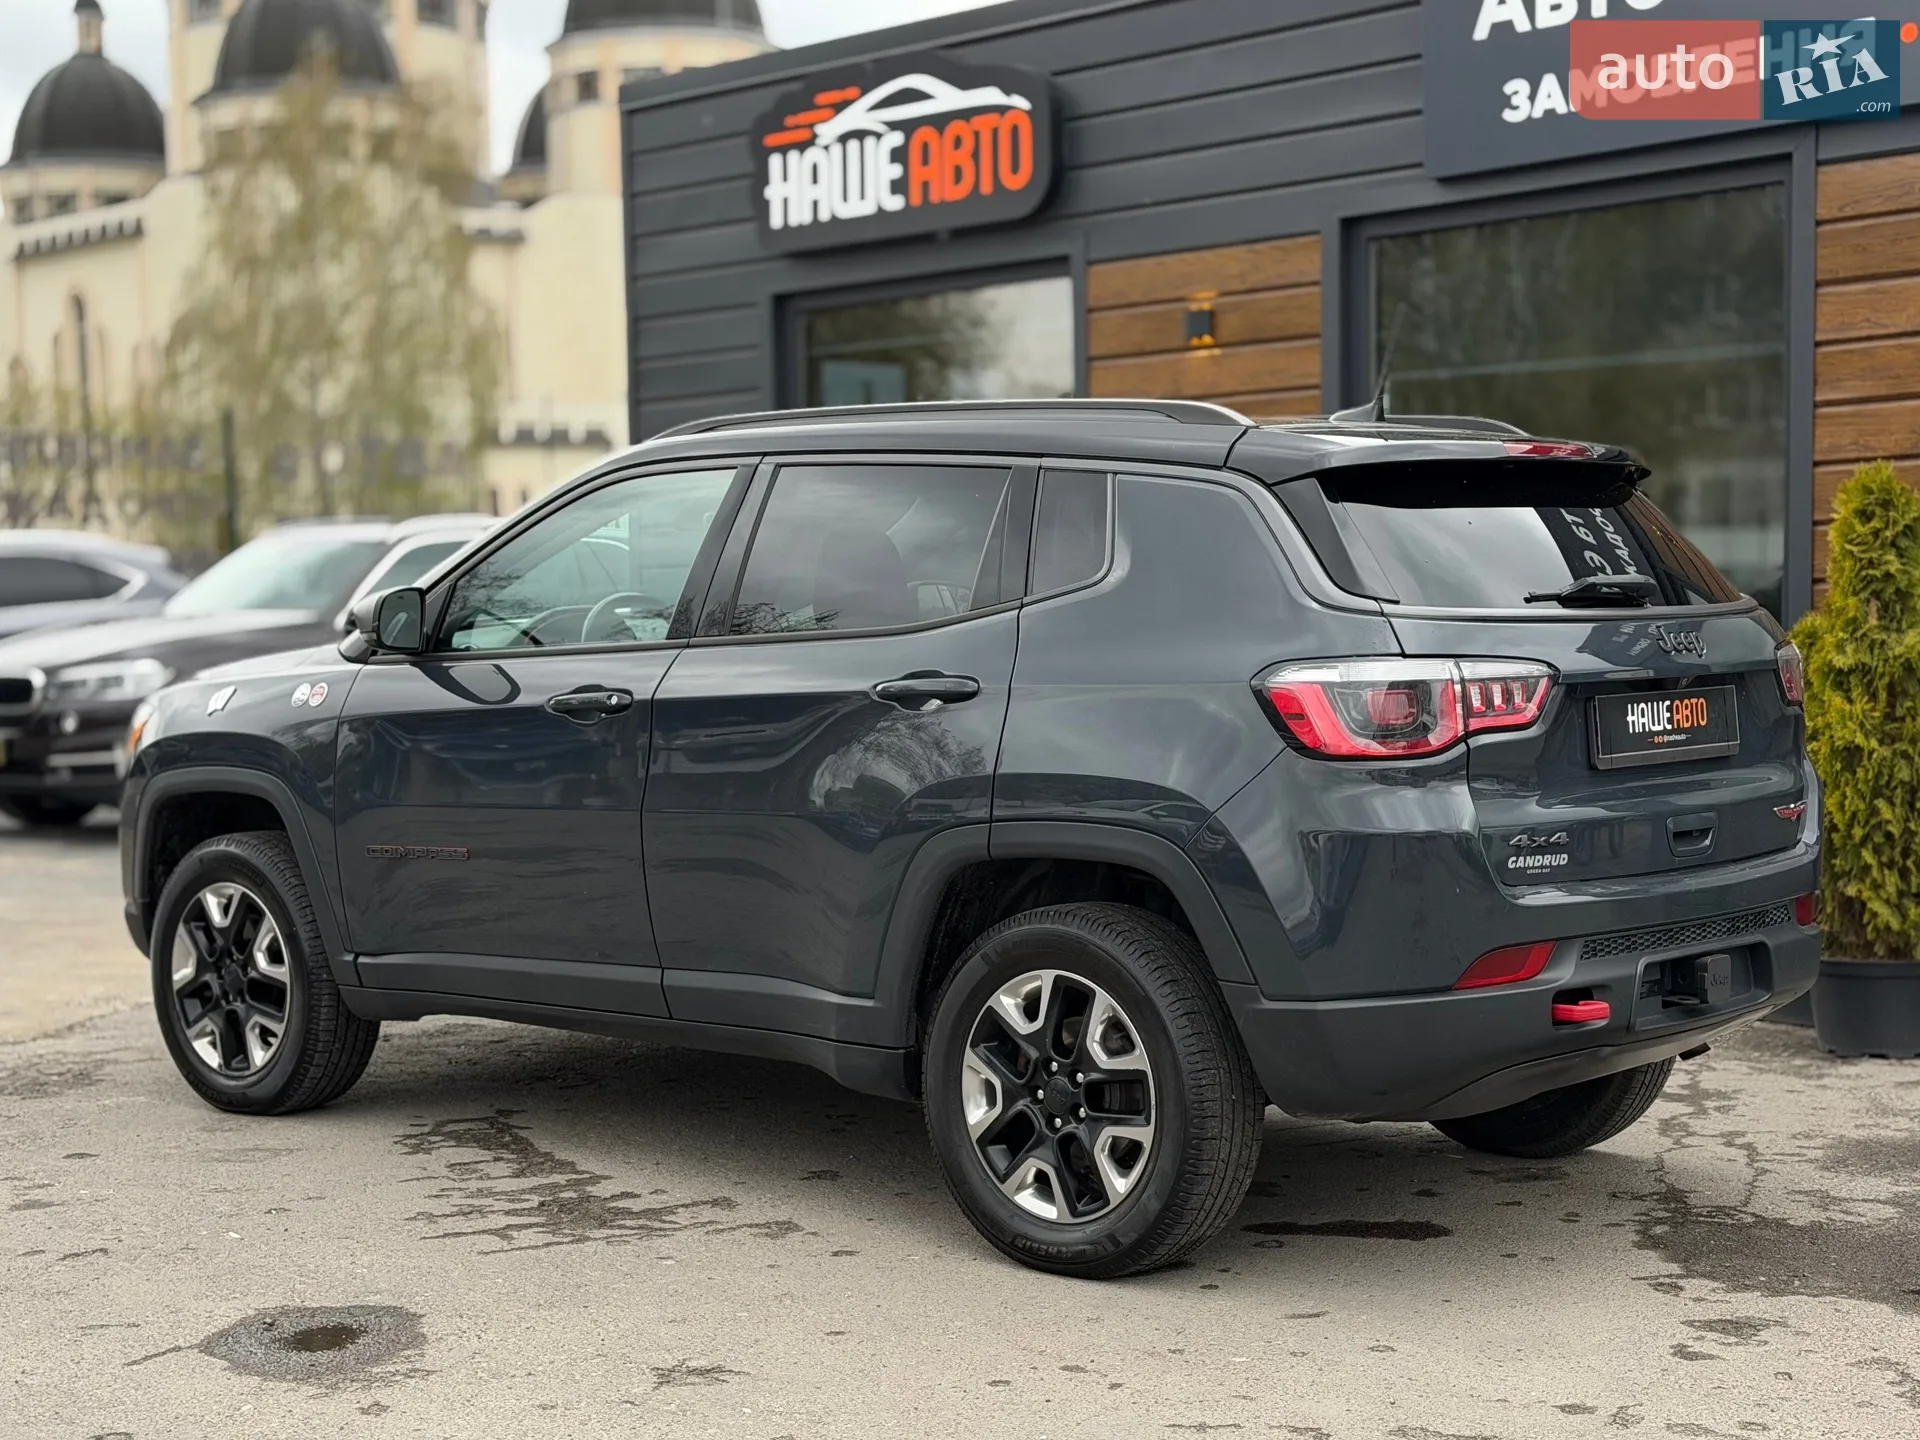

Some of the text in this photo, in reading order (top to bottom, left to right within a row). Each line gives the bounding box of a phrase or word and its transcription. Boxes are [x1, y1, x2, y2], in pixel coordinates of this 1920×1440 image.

[1656, 625, 1706, 658] Jeep
[1508, 832, 1570, 848] 4x4
[365, 845, 470, 861] COMPASS
[1507, 854, 1569, 869] GANDRUD
